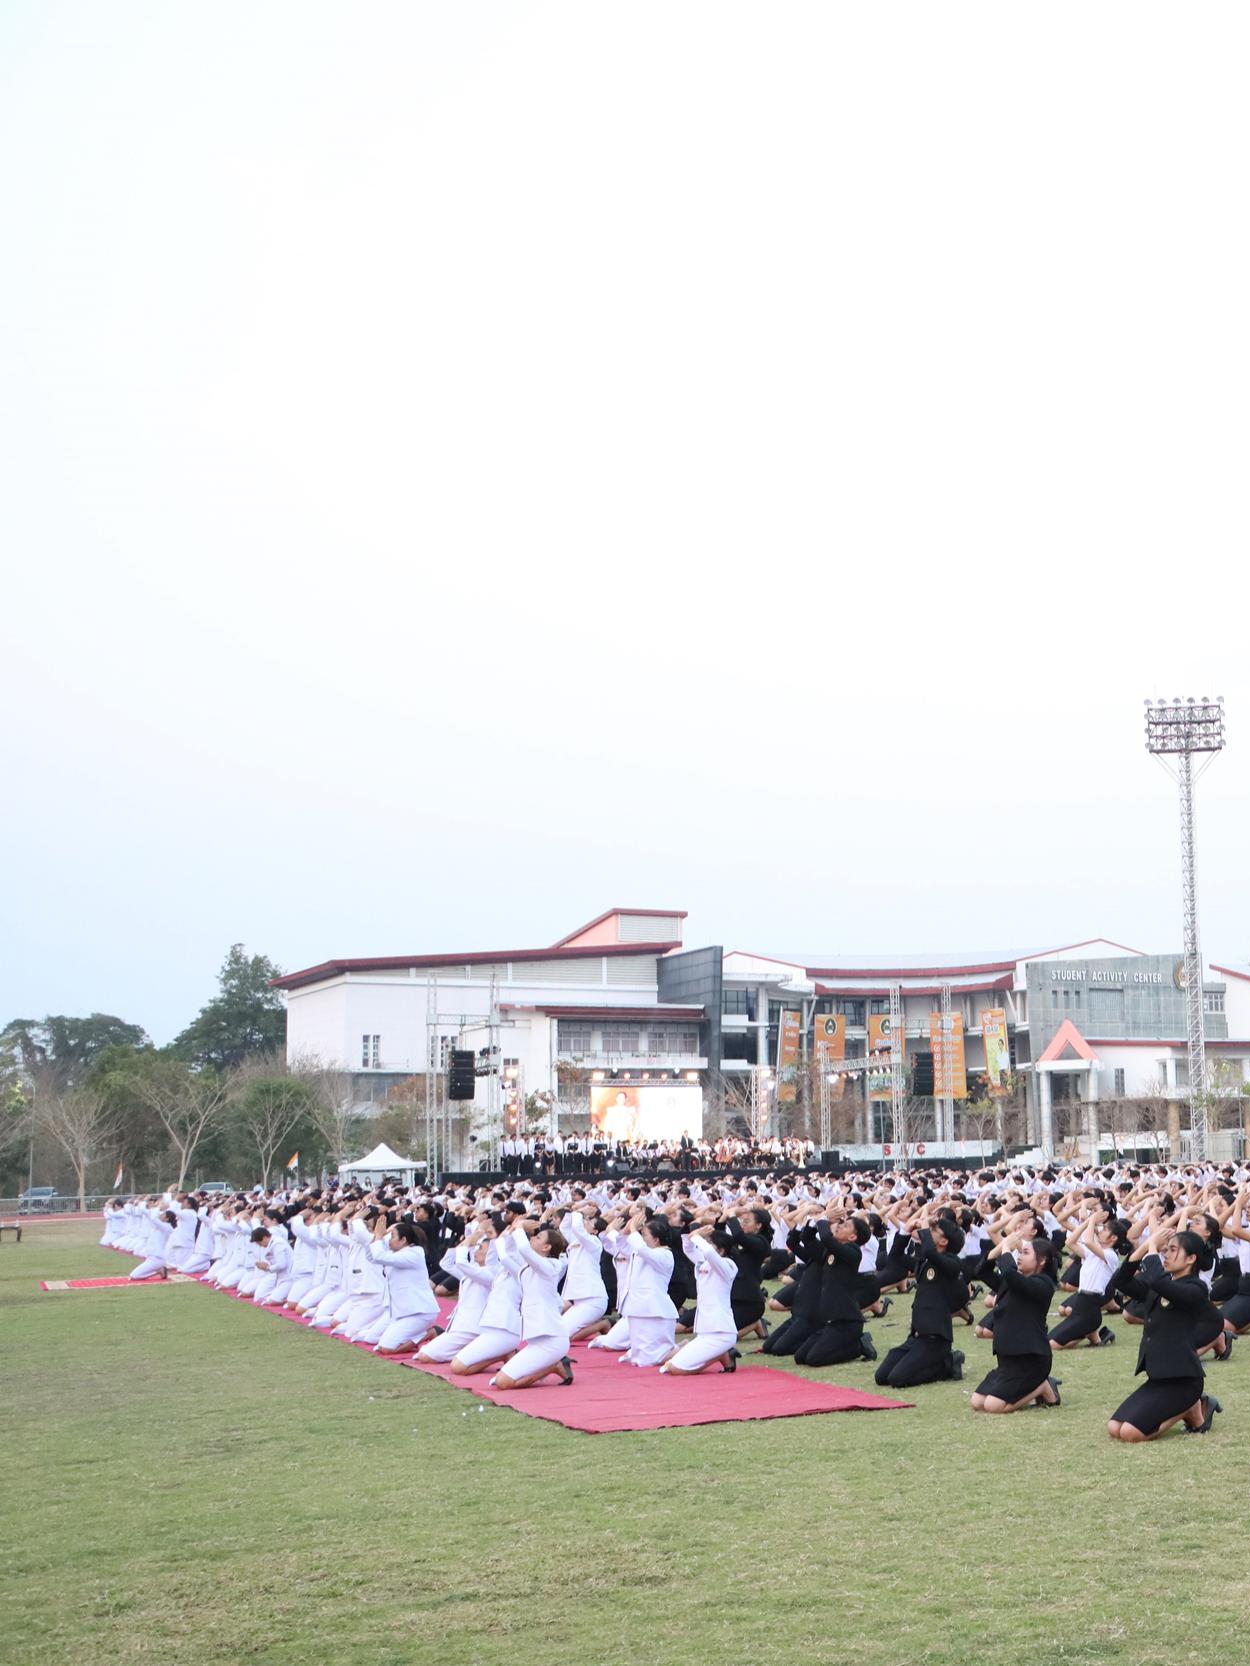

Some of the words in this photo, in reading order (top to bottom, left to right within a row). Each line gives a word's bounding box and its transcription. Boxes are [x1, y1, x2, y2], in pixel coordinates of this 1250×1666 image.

[1051, 969, 1087, 981] STUDENT
[1092, 970, 1128, 982] ACTIVITY
[1134, 972, 1162, 984] CENTER
